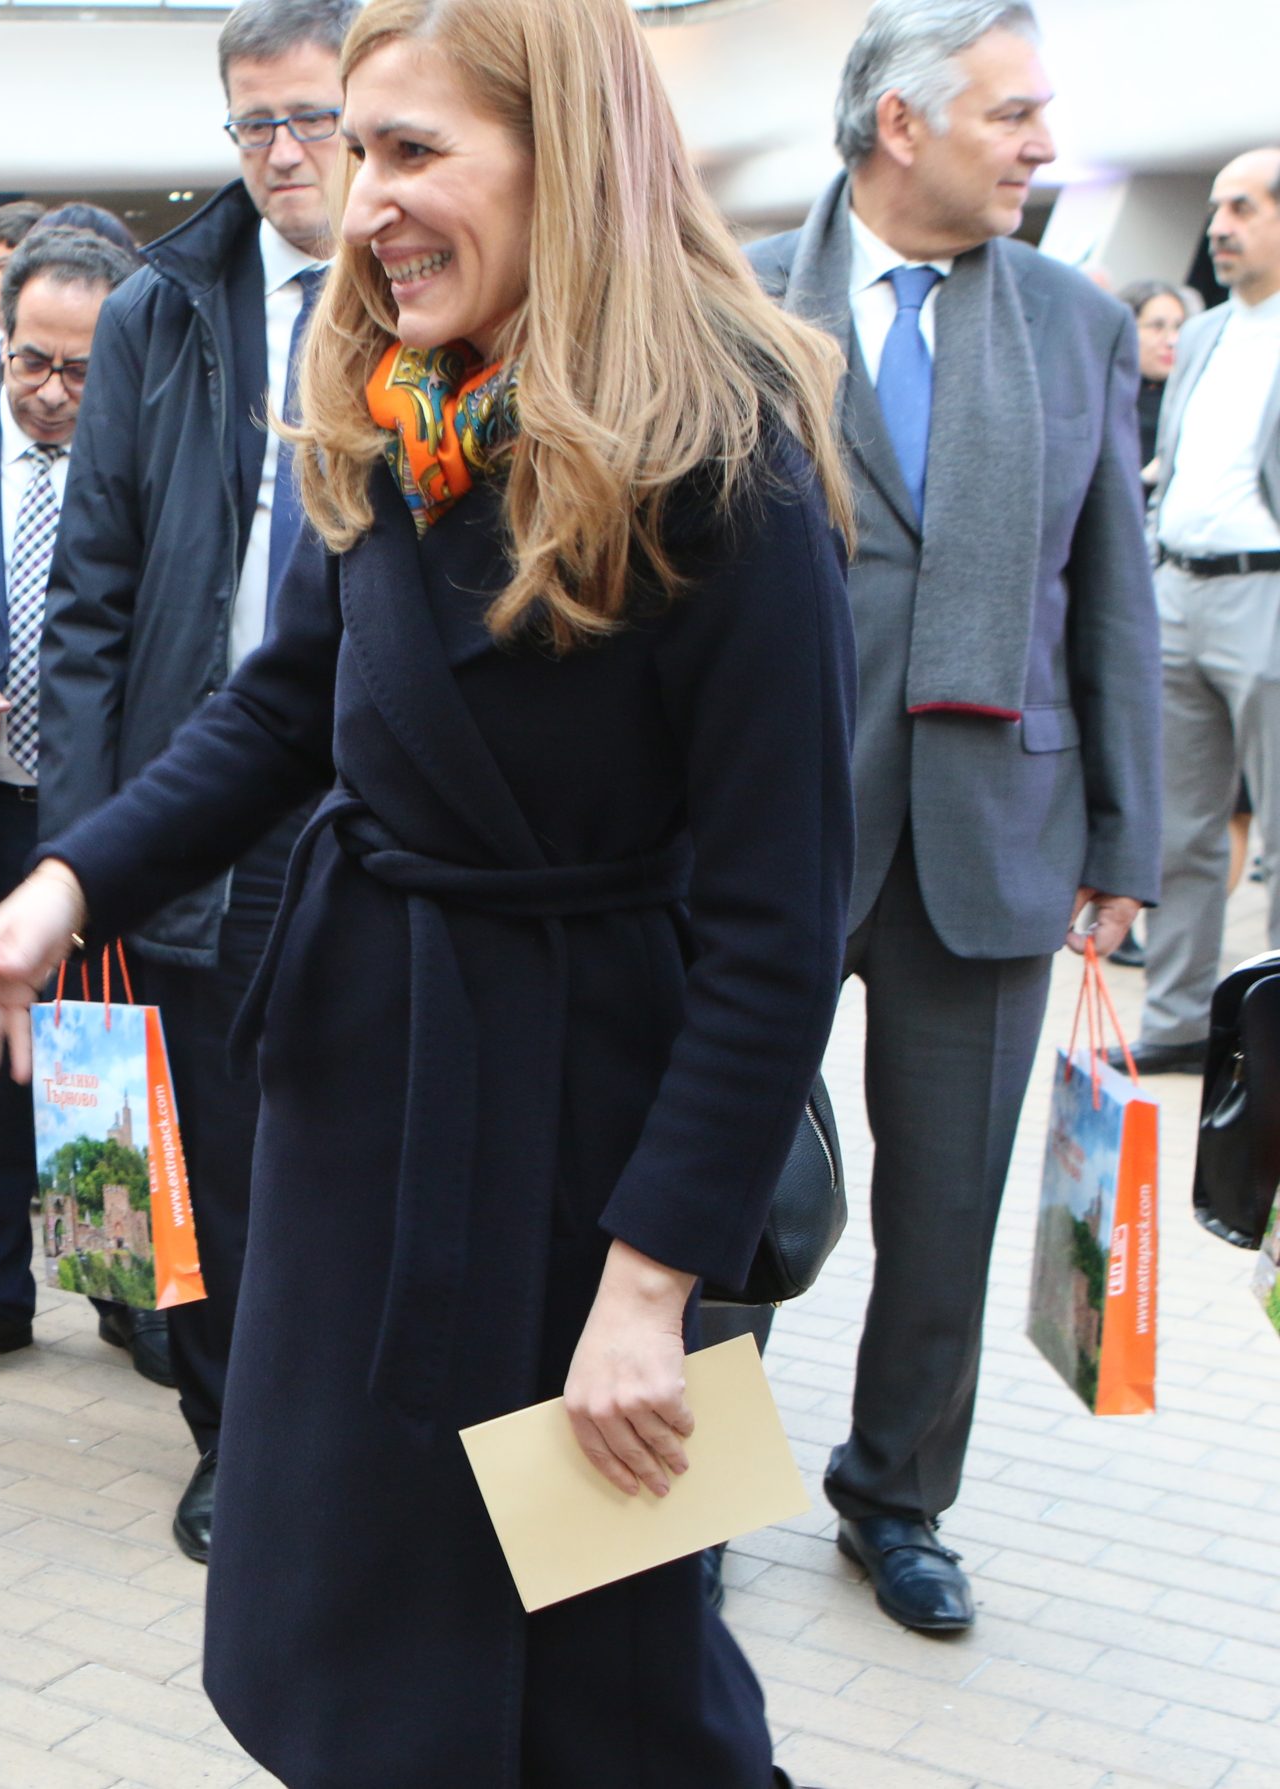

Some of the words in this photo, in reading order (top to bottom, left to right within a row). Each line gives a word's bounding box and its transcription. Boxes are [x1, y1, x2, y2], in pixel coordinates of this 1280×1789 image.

[42, 1078, 98, 1111] Търново
[54, 1062, 99, 1089] Велико
[154, 1083, 186, 1228] www.extrapack.com
[1136, 1184, 1152, 1335] www.extrapack.com
